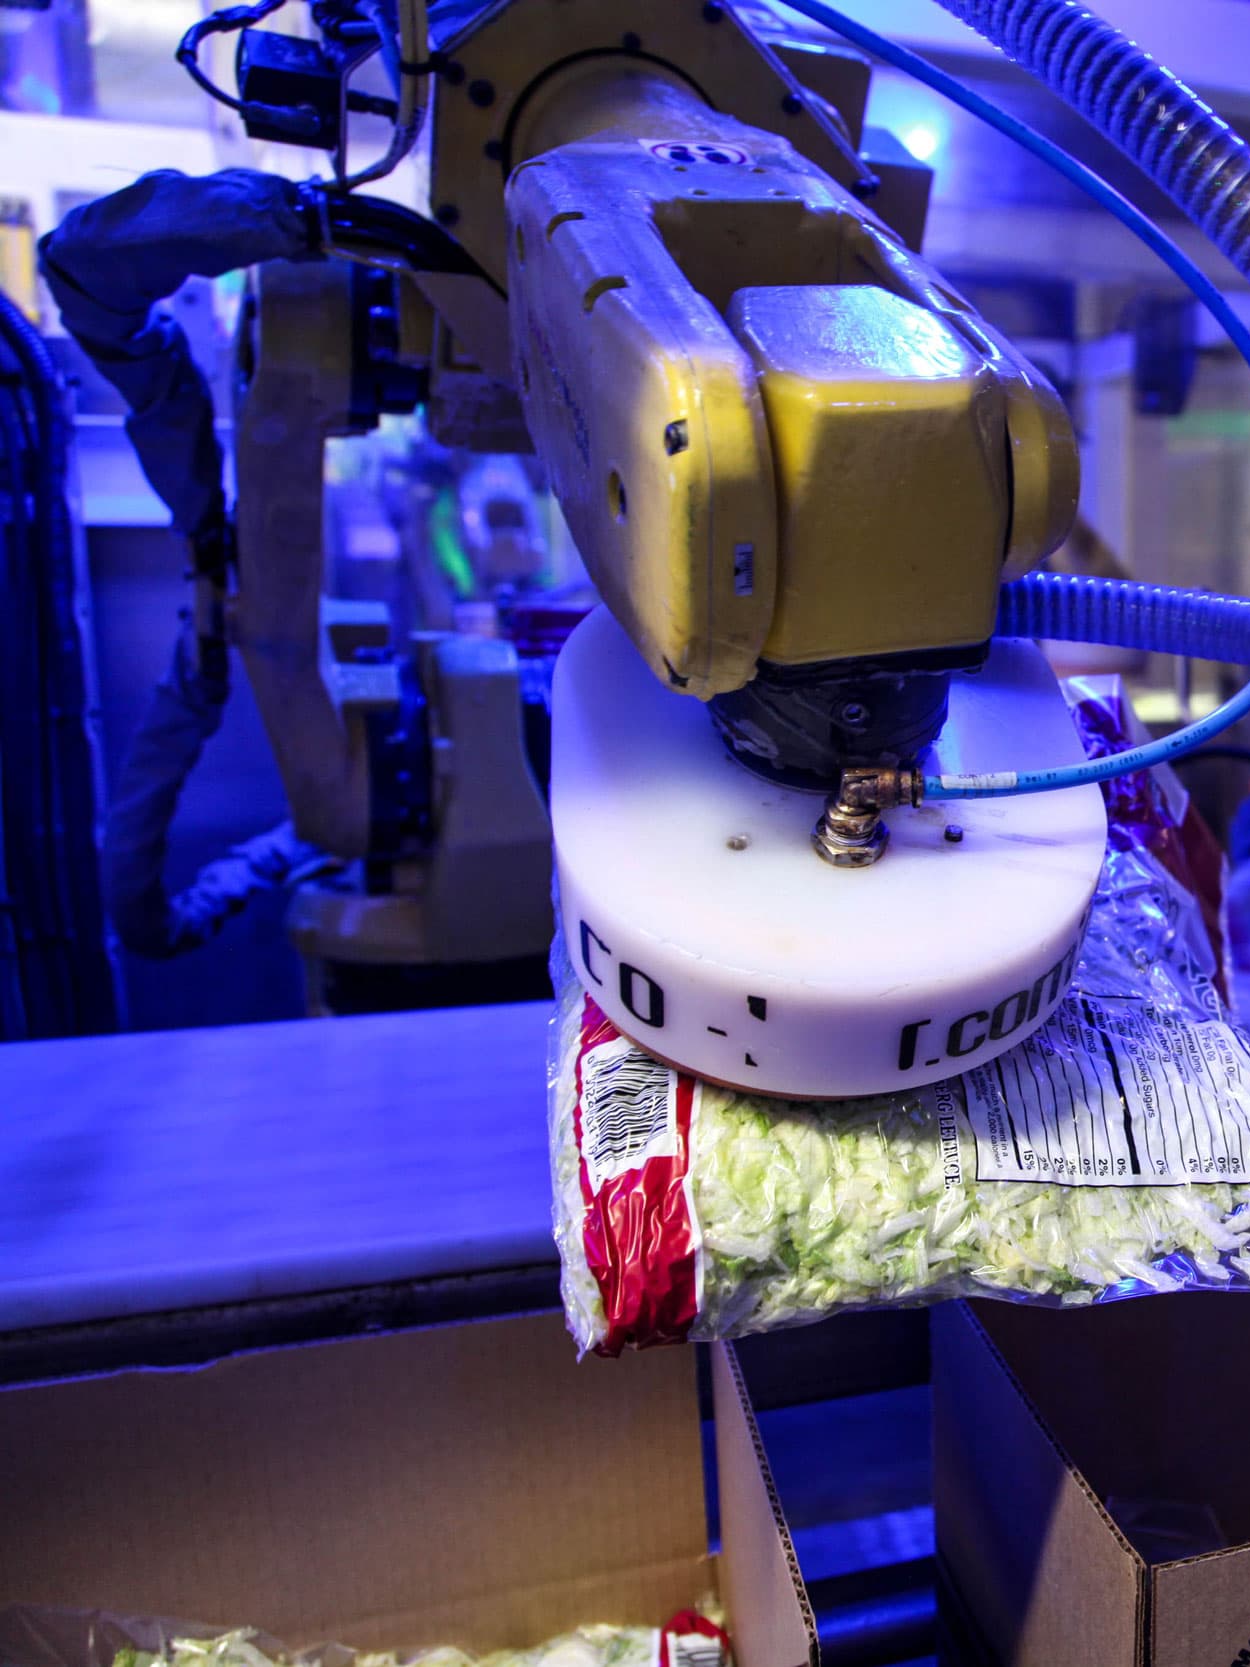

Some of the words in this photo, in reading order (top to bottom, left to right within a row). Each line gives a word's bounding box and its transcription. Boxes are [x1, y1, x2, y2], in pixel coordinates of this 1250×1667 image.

[1142, 1084, 1156, 1119] Sugars
[1022, 1149, 1036, 1171] 15%
[1053, 1157, 1066, 1174] 2%
[1083, 1158, 1093, 1176] 0%
[1098, 1158, 1109, 1177] 2%
[1116, 1157, 1128, 1176] 0%
